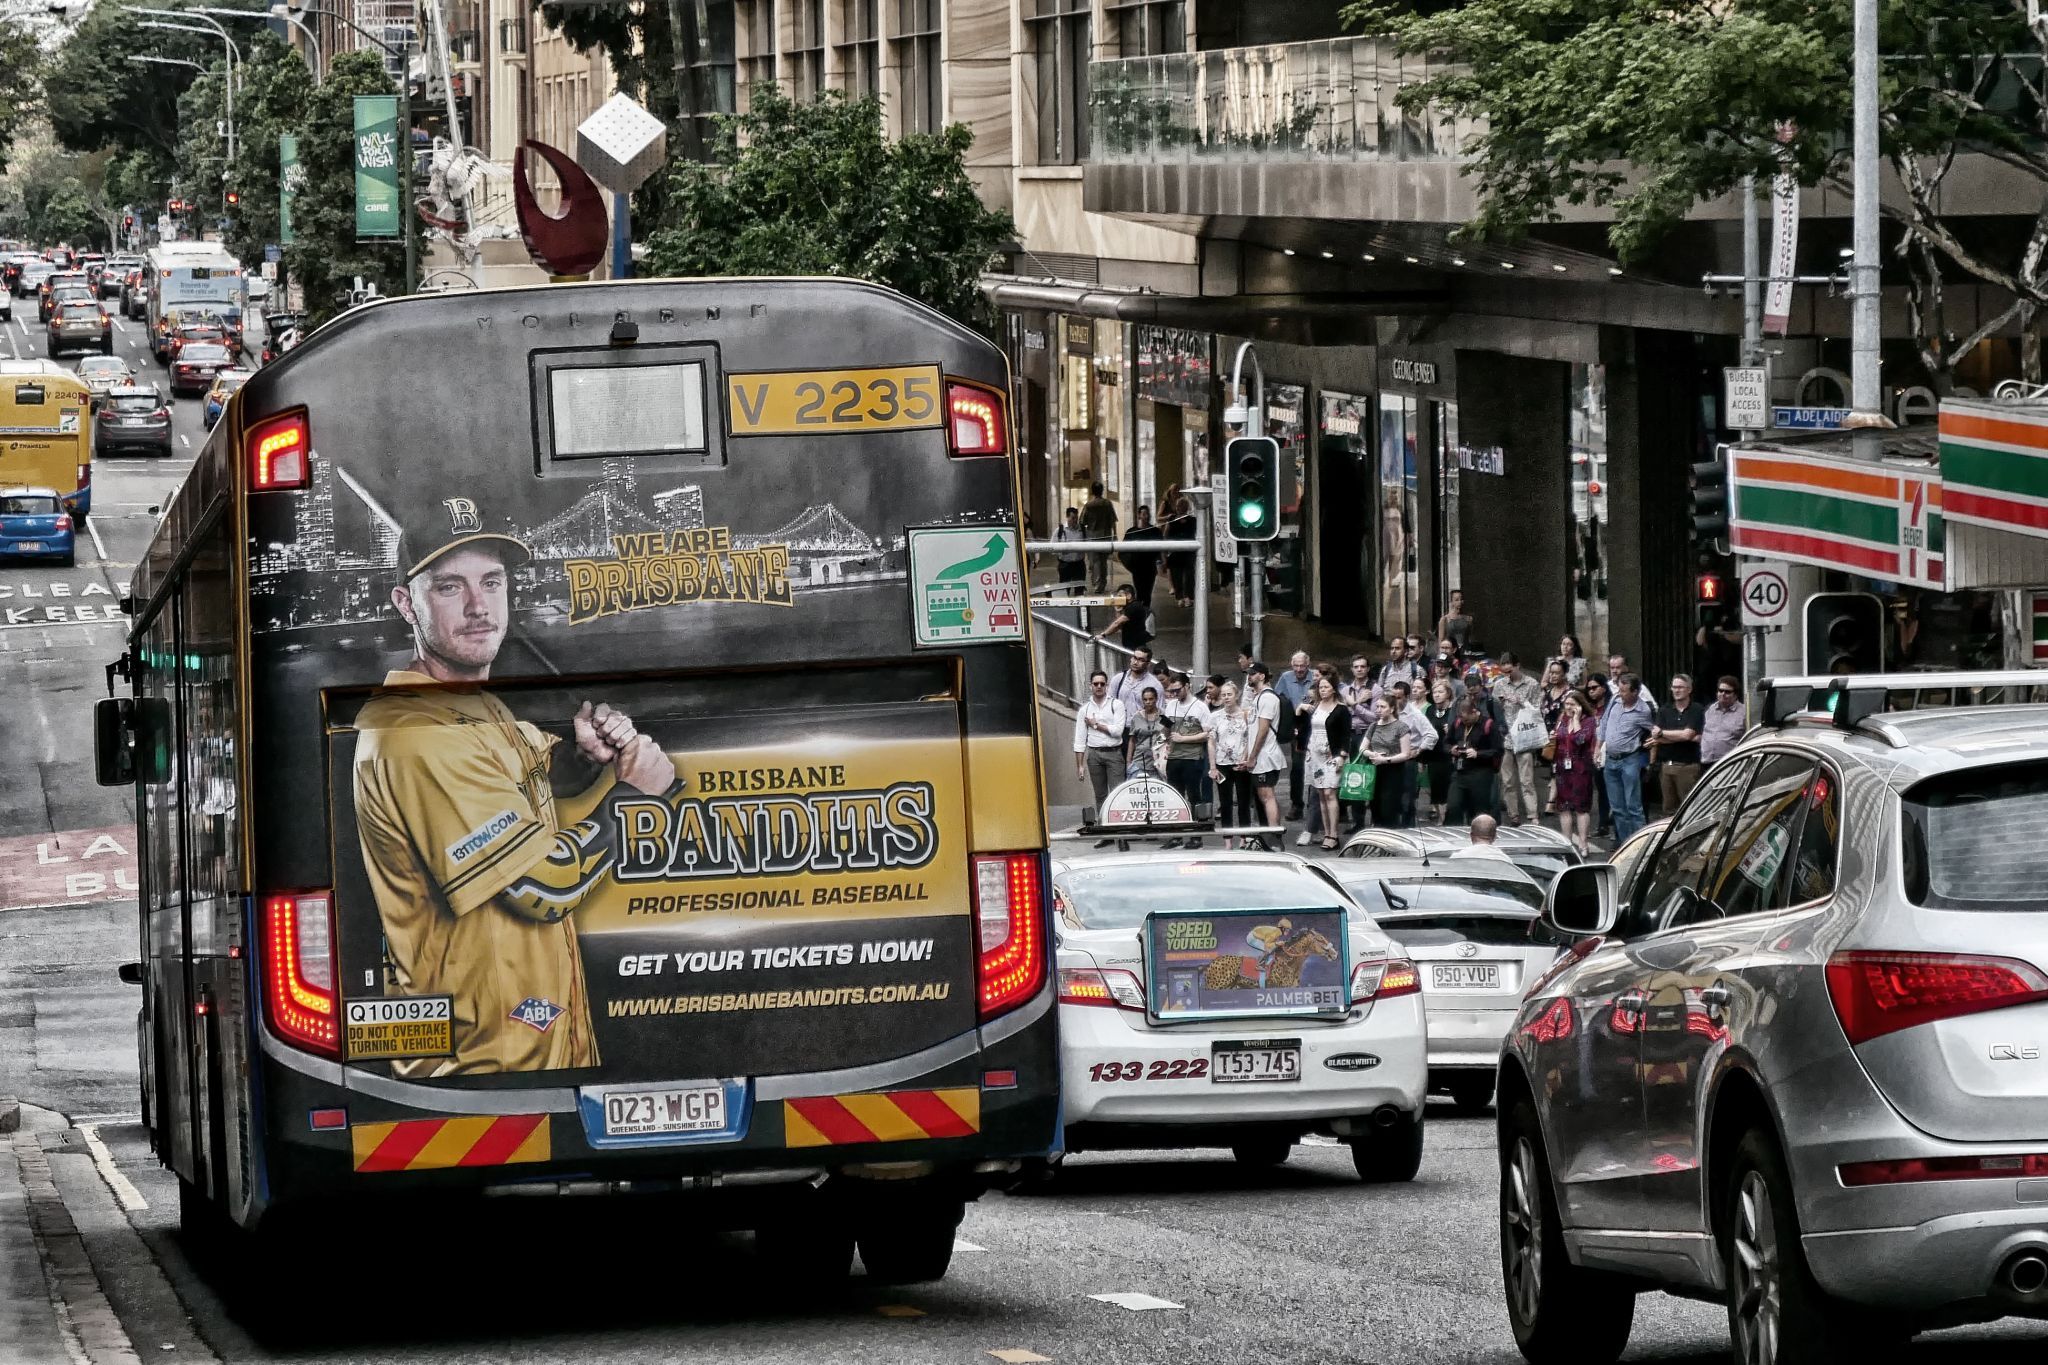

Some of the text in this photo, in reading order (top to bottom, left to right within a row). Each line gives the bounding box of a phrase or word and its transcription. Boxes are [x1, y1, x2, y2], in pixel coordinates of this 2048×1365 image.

[360, 132, 395, 148] WALK
[358, 153, 394, 168] WISH
[1729, 372, 1763, 383] BUSES &
[1734, 386, 1759, 397] LOCAL
[733, 383, 769, 426] V
[794, 377, 935, 424] 2235
[1732, 400, 1762, 410] ACCESS
[1738, 413, 1754, 423] ONLY
[443, 498, 482, 535] B
[614, 526, 732, 561] WE ARE
[564, 543, 794, 626] BRISBANE
[980, 572, 1018, 586] GIVE
[983, 588, 1018, 602] WAY
[1749, 583, 1782, 606] 40
[699, 765, 846, 793] BRISBANE
[1128, 786, 1165, 795] BLACK
[1130, 801, 1165, 809] WHTE
[1120, 809, 1180, 822] 133 222
[613, 783, 937, 881] BANDITS
[627, 883, 929, 915] PROFESSIONAL BASEBALL
[1166, 921, 1213, 939] SPEED
[1166, 937, 1218, 951] YOU NEED
[618, 940, 935, 977] GET YOUR TICKETS NOW!
[607, 983, 950, 1018] WWW.BRISBANEBANDITS.COM.AU
[1256, 990, 1340, 1006] PALMERBET
[350, 1001, 448, 1022] Q100922
[522, 1006, 555, 1024] ABL
[349, 1022, 447, 1040] DO NOT OVERTAKE
[350, 1036, 447, 1054] TURNING VEHICLE
[1988, 1042, 2041, 1060] Q5
[1088, 1058, 1210, 1082] 133 222
[611, 1120, 721, 1133] QUEENSLAND SUNSHINE STATE
